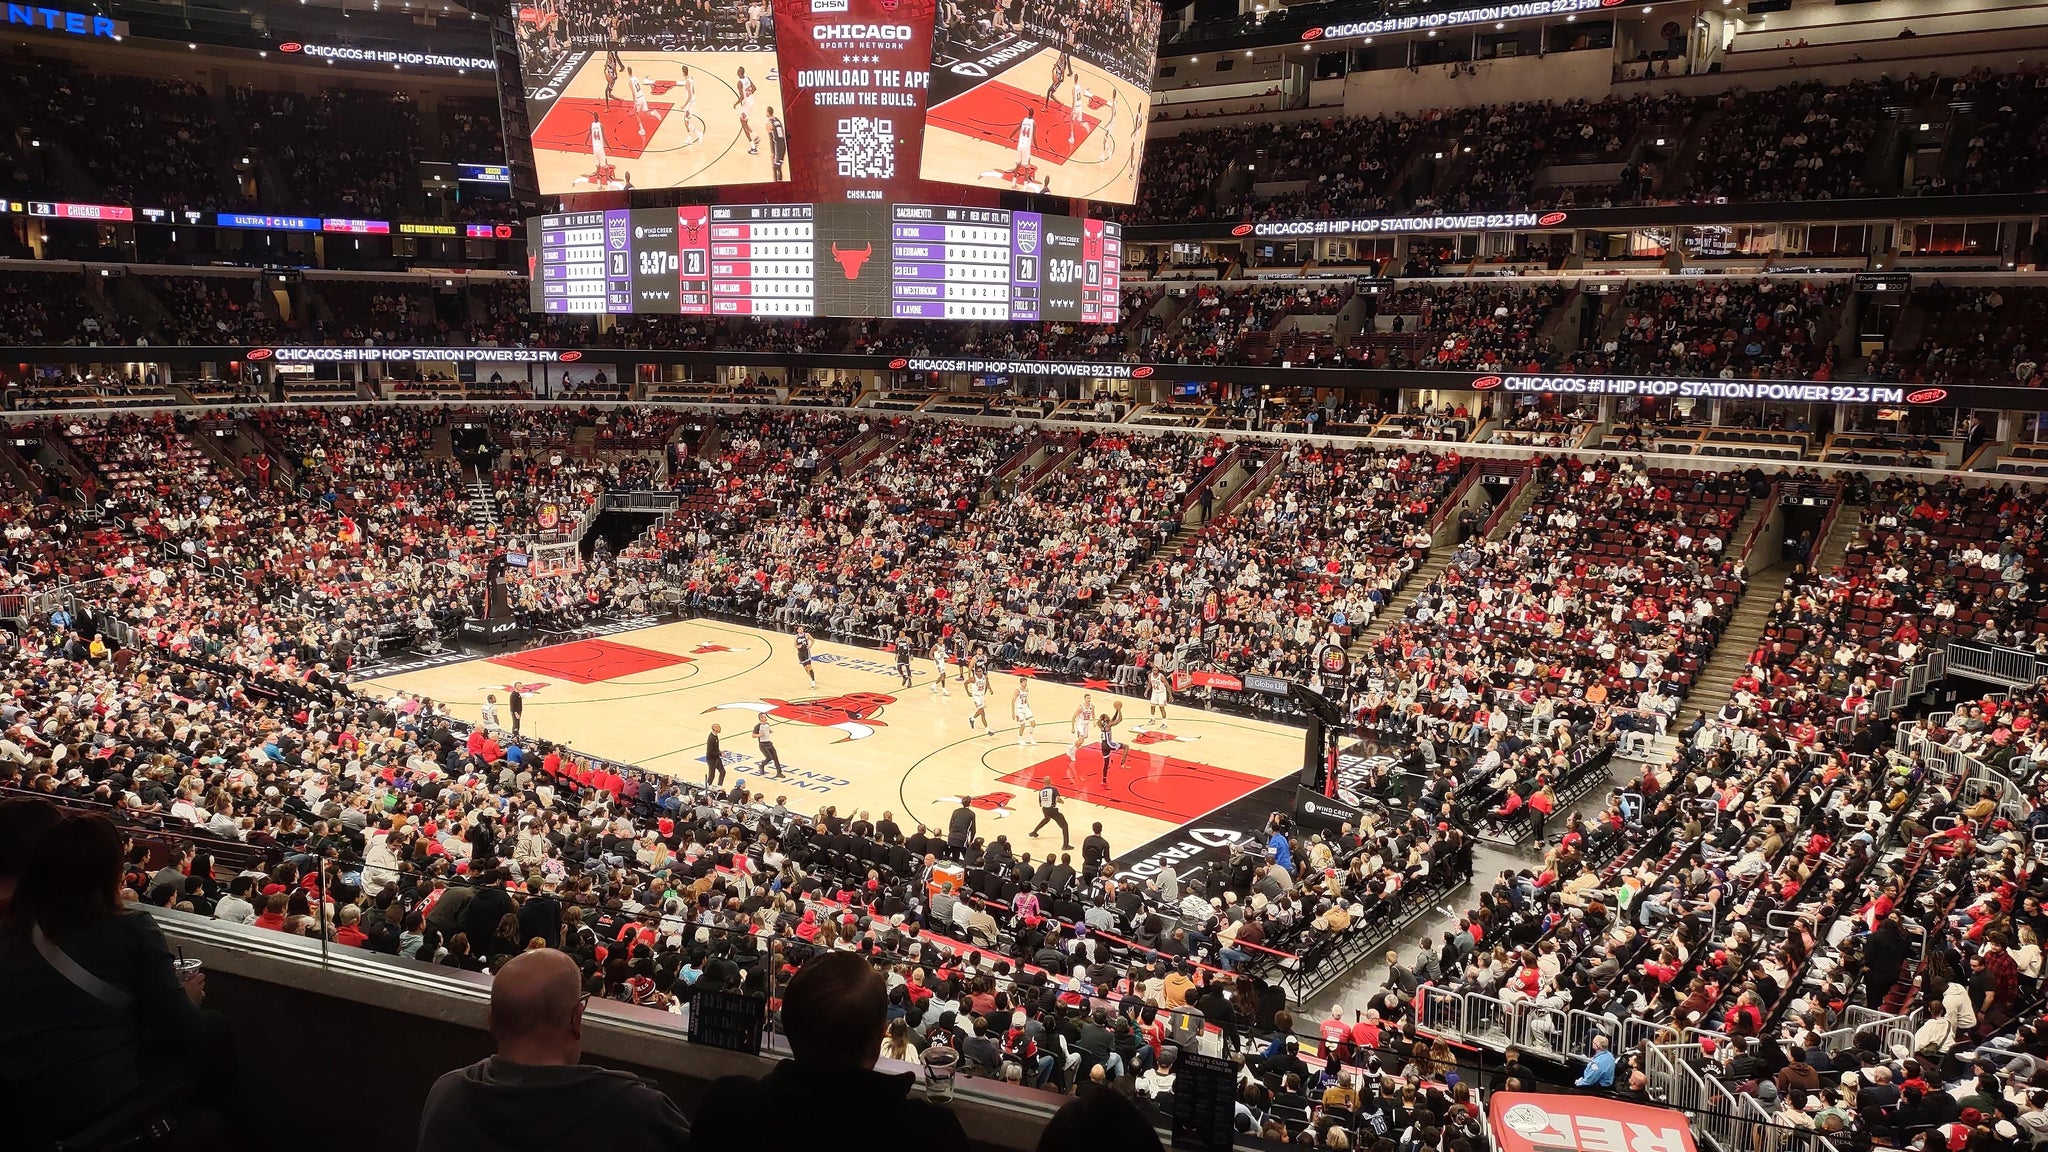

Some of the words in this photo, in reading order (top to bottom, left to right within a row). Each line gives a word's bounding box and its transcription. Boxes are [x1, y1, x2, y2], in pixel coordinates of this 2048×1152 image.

[814, 0, 845, 9] CHSN
[1324, 21, 1382, 38] CHICAGOS
[1384, 20, 1396, 31] #1
[1398, 17, 1418, 29] HIP
[1420, 14, 1447, 27] HOP
[1448, 9, 1500, 25] STATION
[1501, 4, 1550, 18] POWER
[1551, 1, 1576, 12] 92.3
[1578, 0, 1599, 10] FM
[813, 24, 912, 40] CHICAGO
[662, 44, 776, 52] CALAMOS
[859, 42, 904, 50] NETWORK
[304, 45, 363, 59] CHICAGOS
[363, 51, 376, 60] #1
[378, 52, 398, 62] HIP
[399, 54, 424, 64] HOP
[424, 55, 470, 68] STATION
[980, 38, 1040, 69] FANDUEL
[548, 51, 587, 88] FANDUEL
[798, 69, 869, 88] DOWNLOAD
[873, 70, 900, 87] THE
[814, 92, 855, 105] STREAM
[858, 93, 878, 105] THE
[881, 93, 917, 107] BULLS.
[1022, 128, 1030, 138] 44
[846, 190, 883, 200] CHSN.COM
[37, 204, 49, 214] 28
[68, 205, 100, 217] CHICAGO
[782, 208, 791, 217] AST
[792, 208, 801, 217] STL
[896, 208, 932, 218] SACRAMENTO
[235, 217, 264, 225] ULTRA
[274, 218, 304, 227] CLUB
[1255, 222, 1313, 234] CHICAGOS
[1315, 221, 1327, 233] #1
[1329, 221, 1350, 232] HIP
[1351, 220, 1378, 231] HOP
[1380, 218, 1434, 230] STATION
[1435, 215, 1485, 229] POWER
[1487, 215, 1514, 227] 92.3
[1515, 213, 1536, 226] FM
[400, 224, 415, 233] FAST
[415, 225, 435, 234] BREAK
[435, 226, 456, 235] POINTS
[613, 254, 624, 273] 20
[640, 251, 667, 274] 3:37
[688, 253, 700, 273] 28
[1021, 259, 1033, 279] 20
[1049, 258, 1074, 282] 3:37
[683, 295, 698, 304] FOULS
[805, 303, 811, 311] 11
[1014, 301, 1028, 311] FOULS
[275, 349, 343, 360] CHICAGOS
[344, 349, 358, 360] #1
[359, 349, 381, 360] HIP
[382, 349, 411, 360] HOP
[412, 350, 464, 360] STATION
[466, 350, 513, 361] POWER
[514, 351, 538, 361] 92.3
[539, 351, 557, 361] FM
[908, 359, 955, 371] CHICAGOS
[956, 361, 966, 371] #1
[967, 361, 984, 372] HIP
[985, 362, 1007, 373] HOP
[1008, 362, 1049, 374] STATION
[1050, 364, 1090, 376] POWER
[1091, 365, 1112, 377] 92.3
[1114, 366, 1130, 377] FM
[1504, 377, 1586, 392] CHICAGOS
[1588, 379, 1604, 392] #1
[1608, 380, 1637, 393] HIP
[1639, 381, 1678, 395] HOP
[1680, 382, 1754, 398] STATION
[1756, 384, 1830, 400] POWER
[1830, 386, 1870, 402] 92.3
[1872, 388, 1903, 403] FM
[492, 622, 516, 633] KIA
[1254, 680, 1274, 689] Globe
[1275, 681, 1287, 691] Life
[1316, 805, 1333, 813] WIND
[1334, 808, 1354, 818] CREEK
[1114, 841, 1204, 888] FANDU
